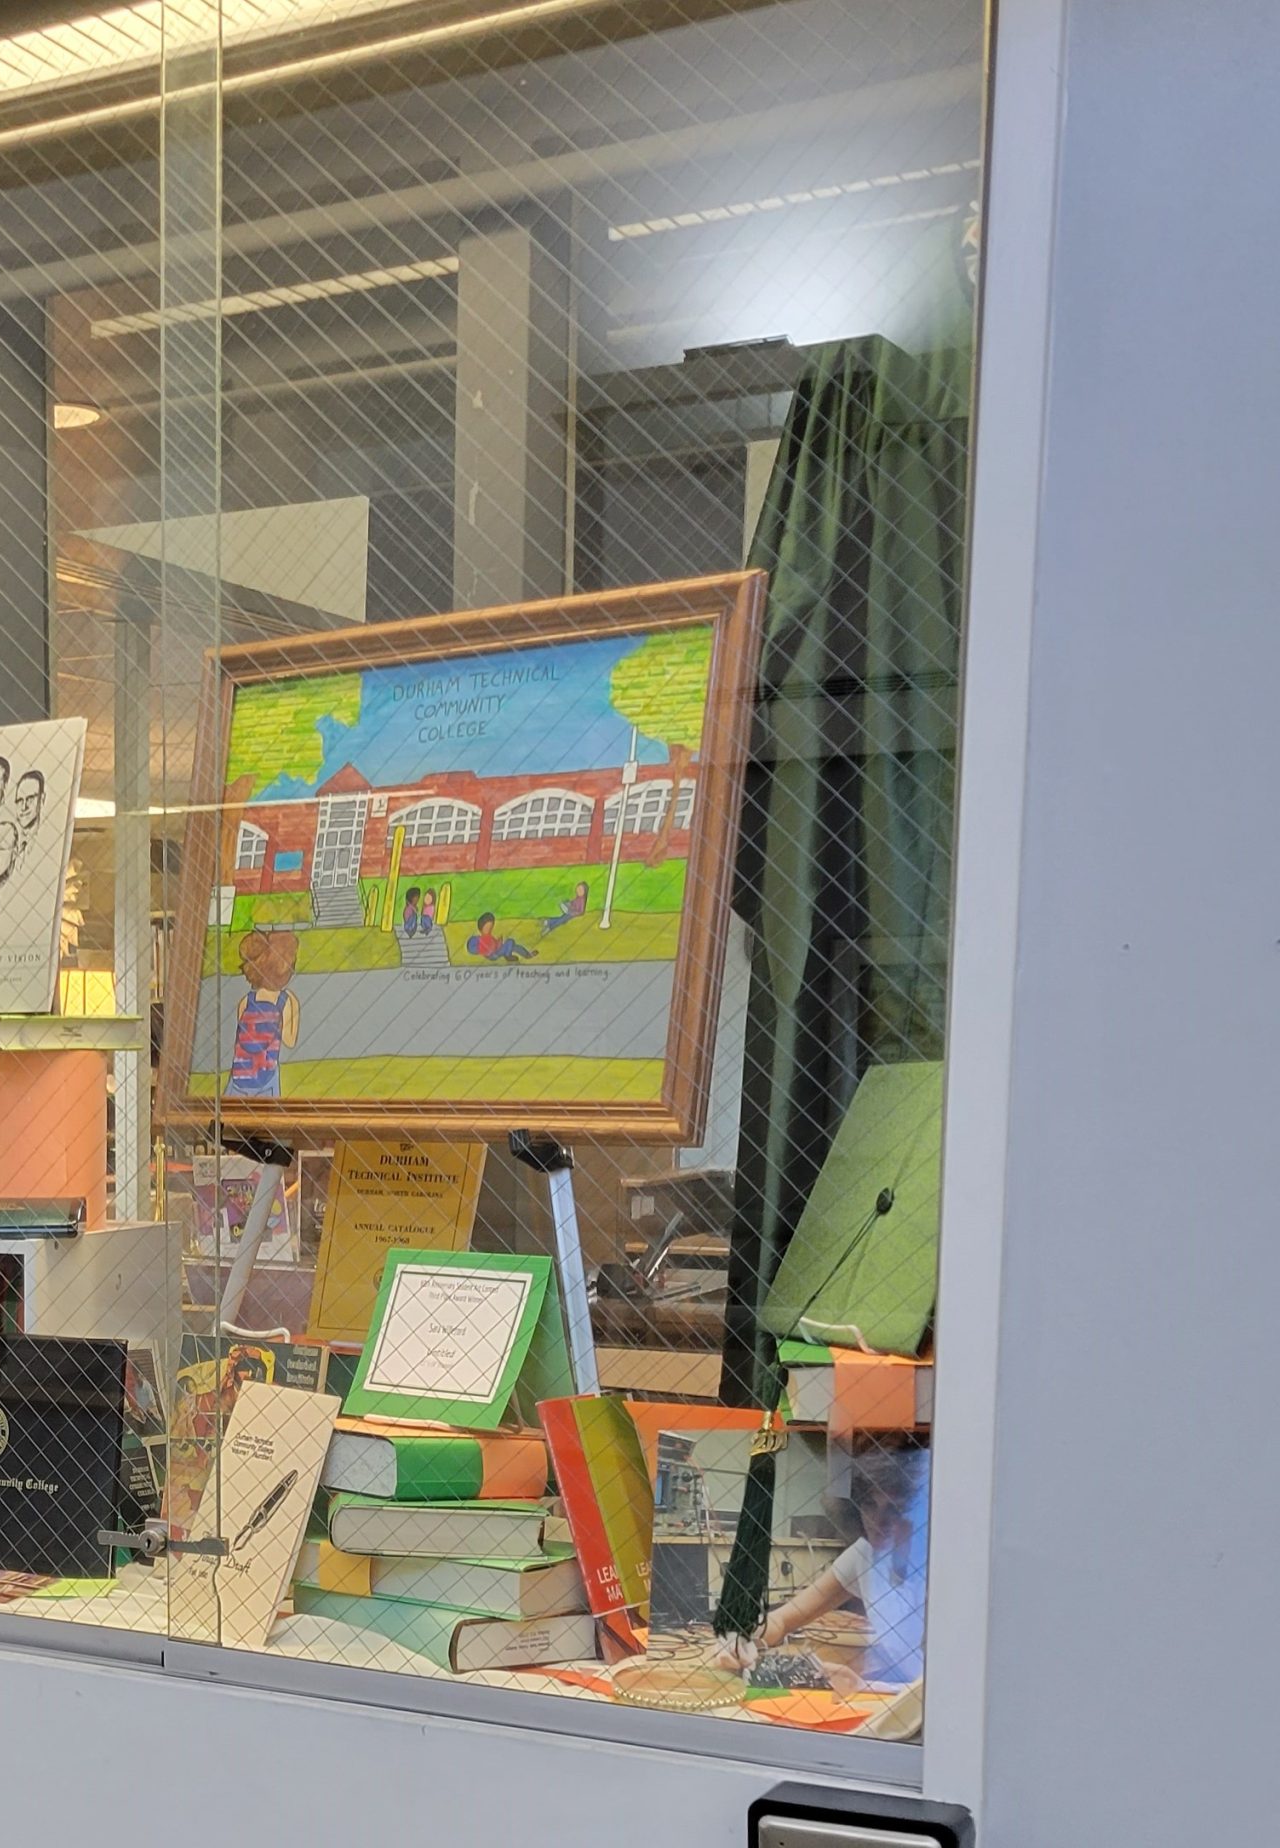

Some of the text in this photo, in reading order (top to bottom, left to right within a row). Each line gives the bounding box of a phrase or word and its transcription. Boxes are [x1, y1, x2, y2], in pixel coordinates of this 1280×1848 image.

[393, 663, 560, 701] DURHAM TECHNICAL
[414, 694, 506, 721] COMMUNITY
[418, 721, 486, 744] COLLEGE
[8, 954, 41, 963] VISION
[403, 970, 450, 984] Celebrating
[455, 970, 470, 980] 60
[476, 970, 498, 982] years
[516, 968, 551, 984] teaching
[555, 968, 570, 978] and
[380, 1154, 429, 1167] DURHAM
[354, 1223, 435, 1234] ANNUAL CATALOGUE
[25, 1478, 59, 1495] College
